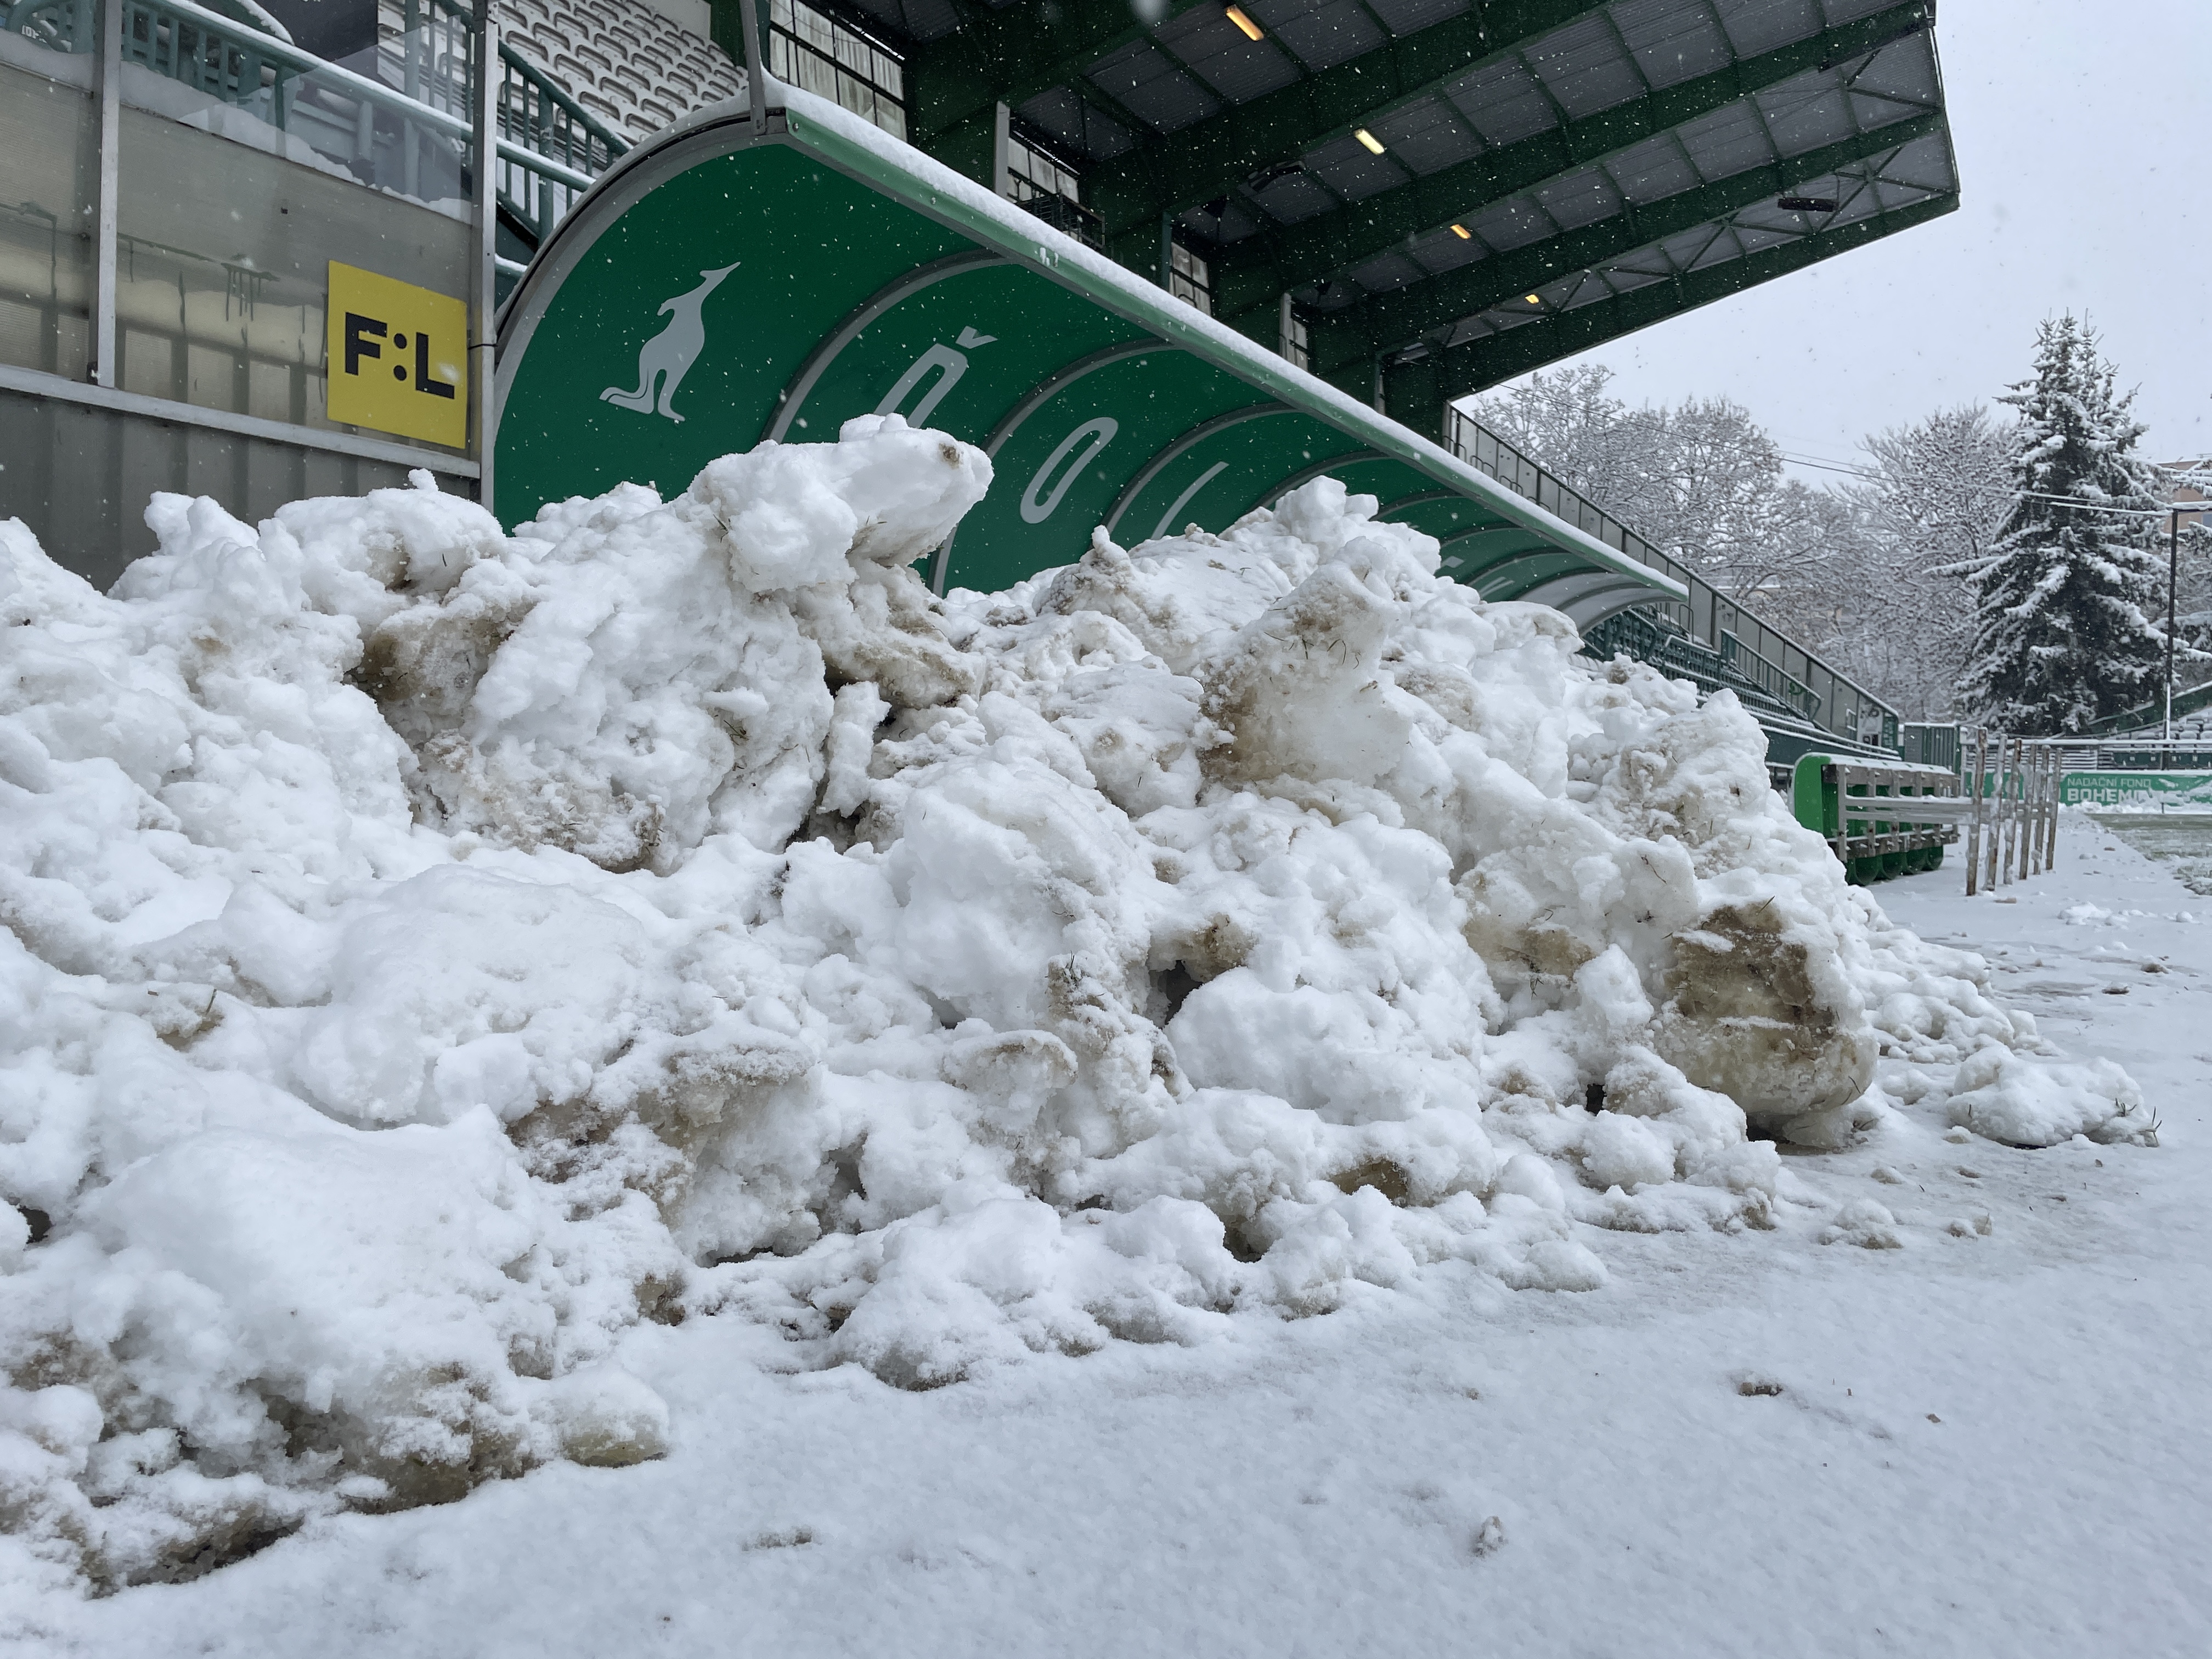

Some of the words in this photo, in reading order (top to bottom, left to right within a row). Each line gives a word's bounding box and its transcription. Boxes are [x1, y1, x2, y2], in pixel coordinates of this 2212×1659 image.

[345, 312, 455, 400] F:L
[2067, 776, 2117, 787] NADAČNÍ
[2120, 778, 2152, 788] FOND
